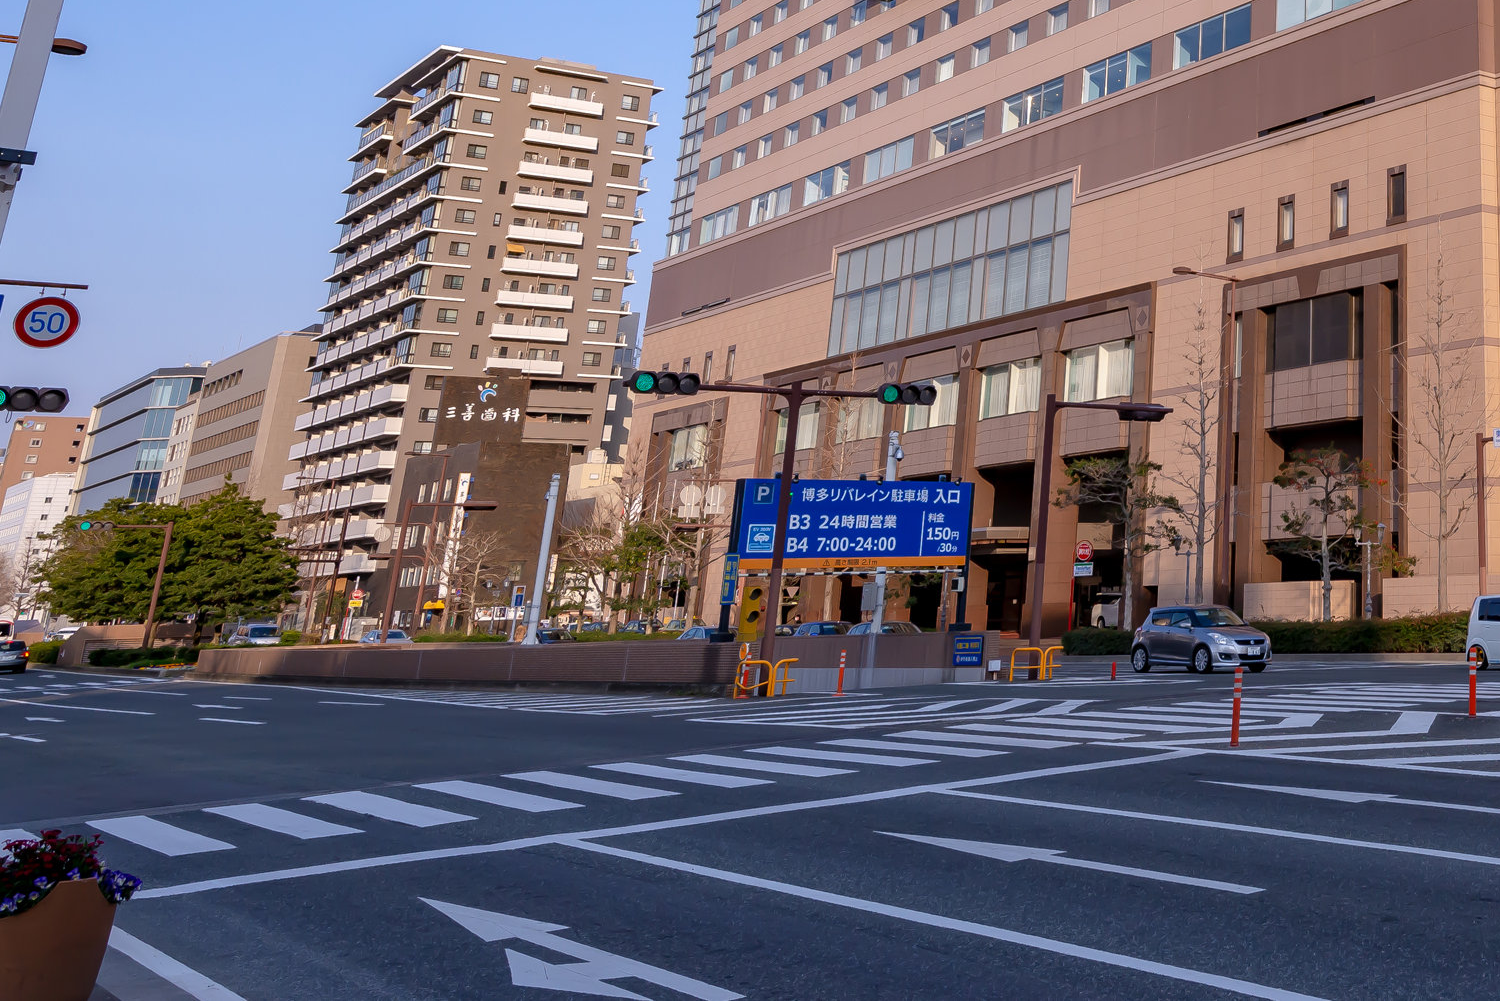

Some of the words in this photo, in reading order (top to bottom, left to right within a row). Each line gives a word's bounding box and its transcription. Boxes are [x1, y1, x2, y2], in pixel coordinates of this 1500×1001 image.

[29, 311, 65, 333] 50
[757, 486, 770, 502] P
[802, 487, 928, 502] 博多リバレイン駐車場
[933, 488, 960, 504] 入口
[789, 514, 811, 529] B3
[819, 514, 897, 529] 24時間営業
[928, 512, 945, 523] 料金
[926, 527, 959, 541] 150円
[786, 537, 808, 553] B4
[816, 537, 896, 552] 7:00-24:00
[937, 543, 957, 553] /30分
